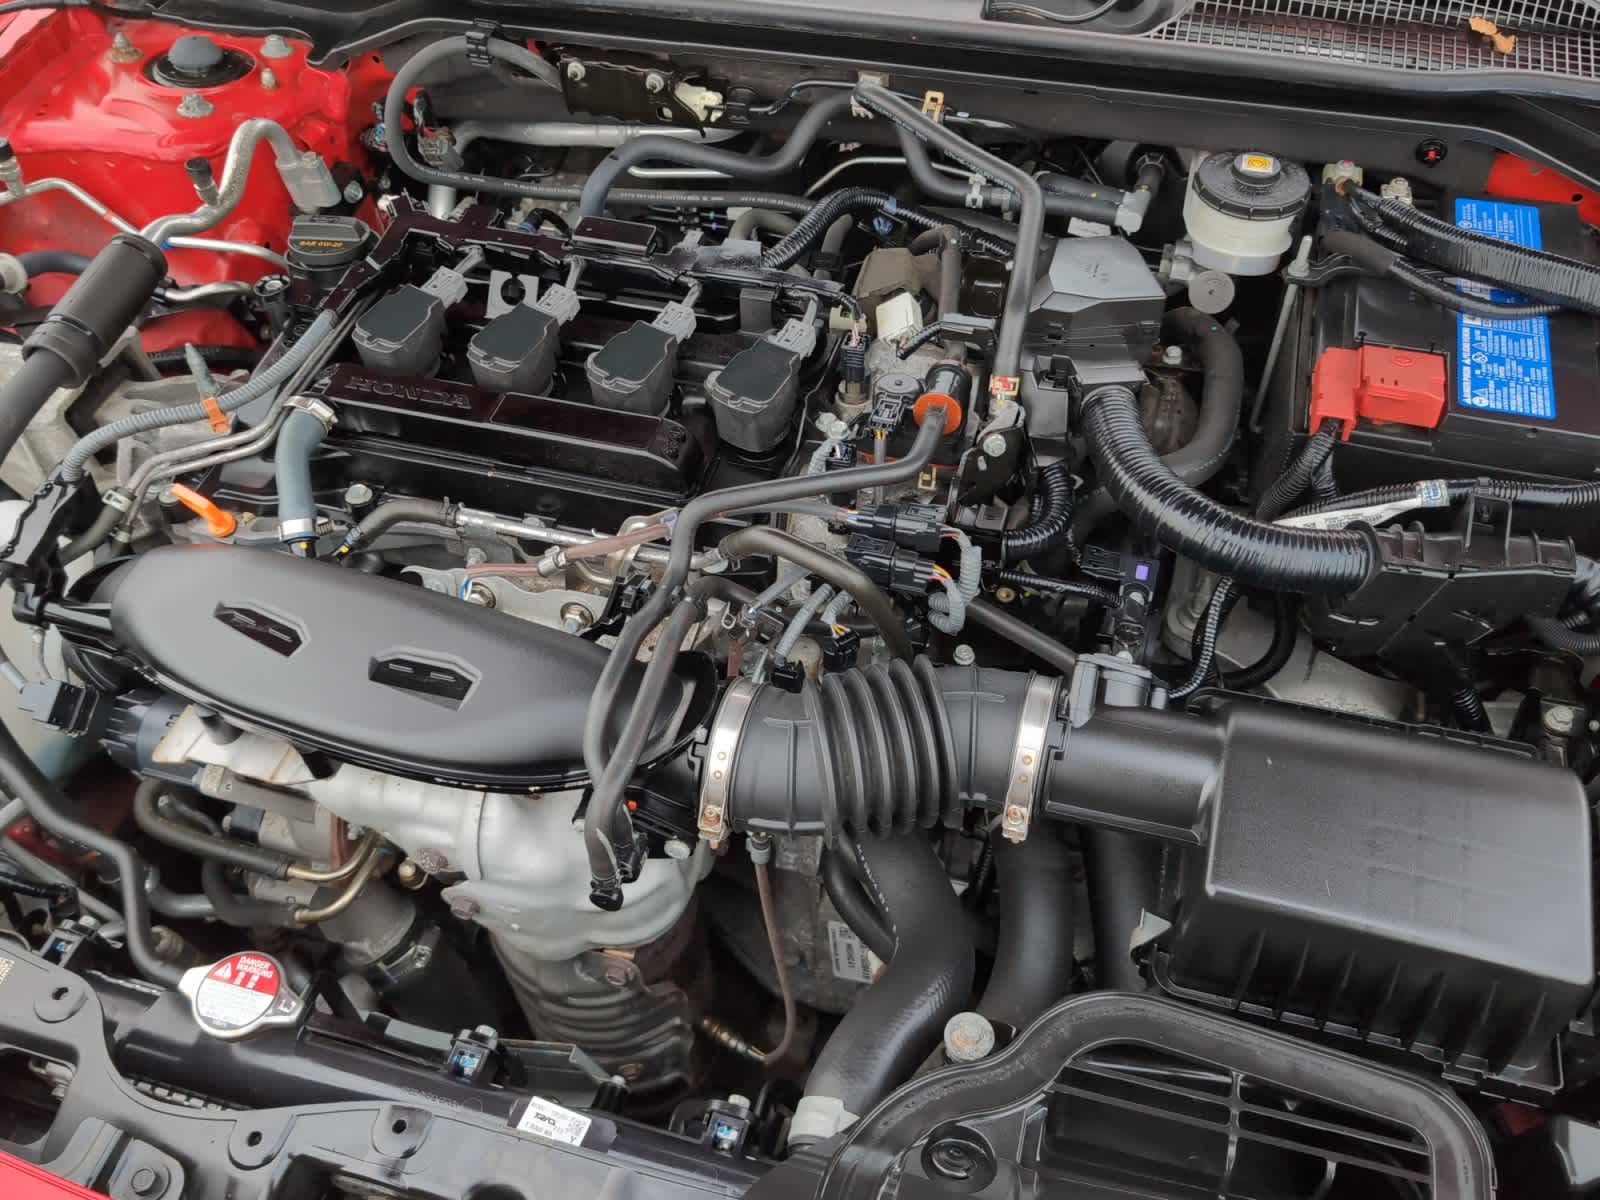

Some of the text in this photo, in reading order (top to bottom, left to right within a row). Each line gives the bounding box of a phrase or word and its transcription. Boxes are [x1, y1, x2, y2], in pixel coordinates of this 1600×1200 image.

[343, 375, 472, 410] HONDA
[235, 962, 274, 979] WARNING
[239, 956, 272, 971] DANGER
